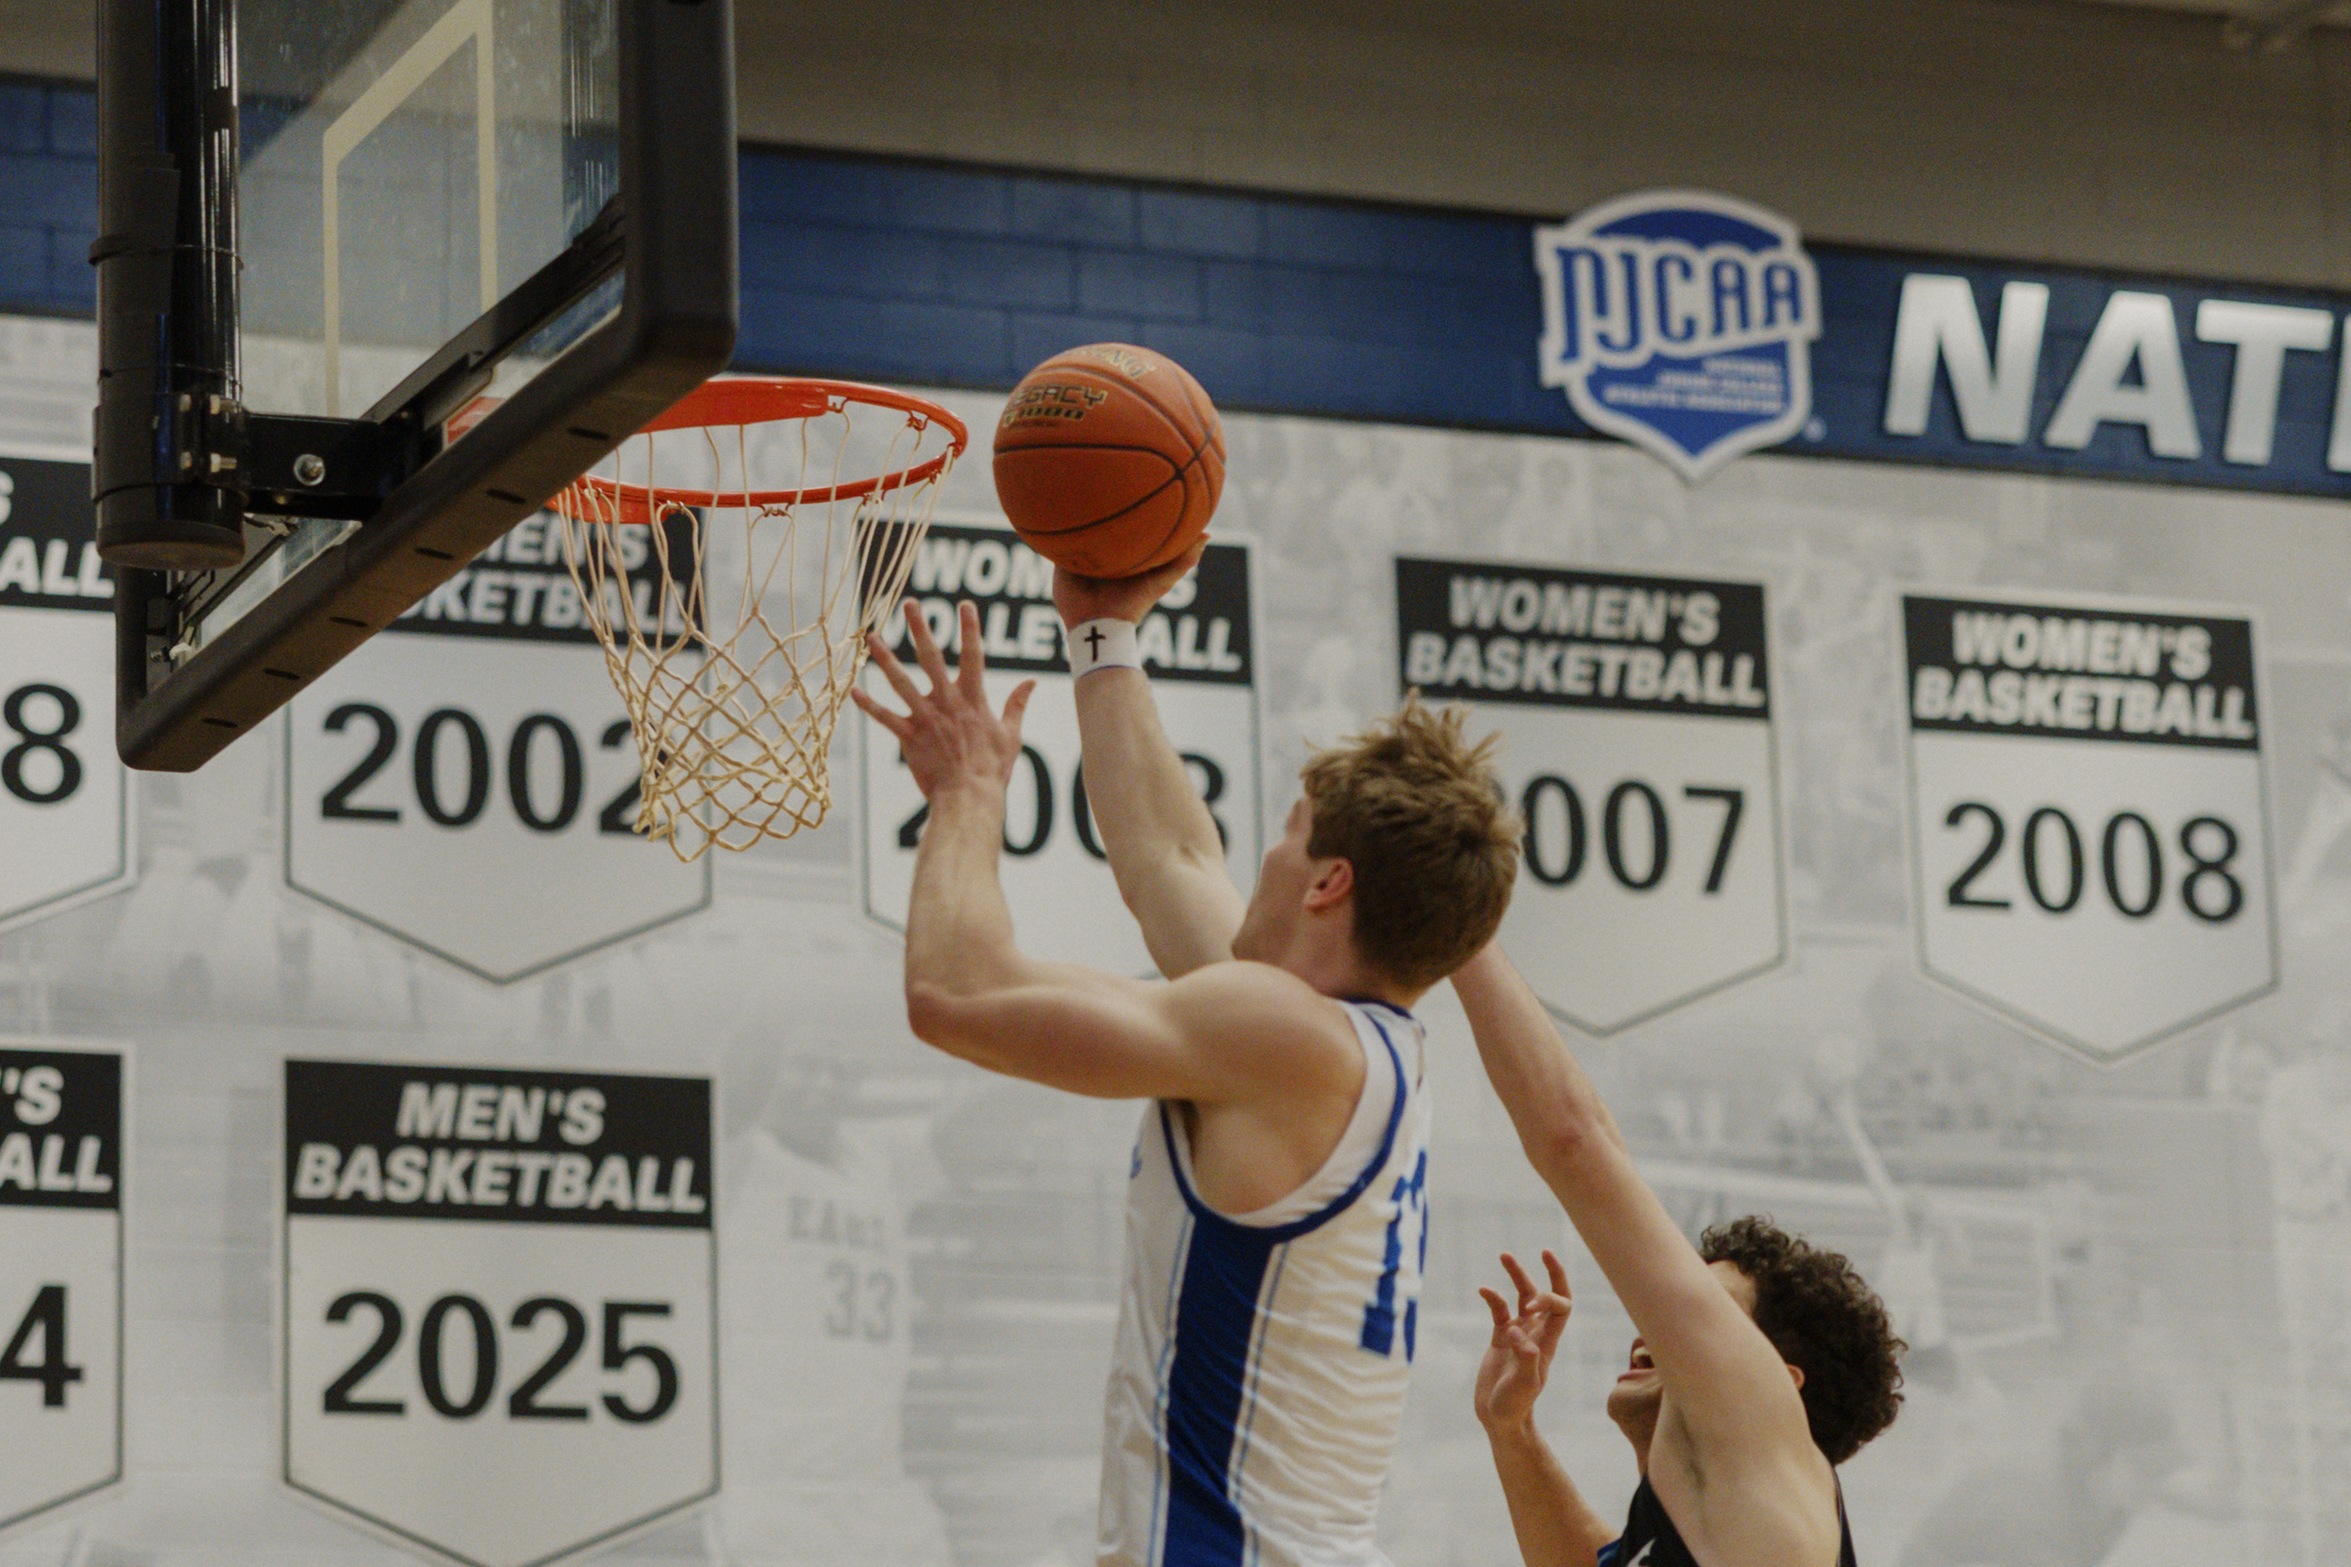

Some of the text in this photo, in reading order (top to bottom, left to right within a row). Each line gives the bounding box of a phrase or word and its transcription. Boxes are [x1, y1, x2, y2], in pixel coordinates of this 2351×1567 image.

[1555, 246, 1804, 362] NJCAA
[1885, 272, 2351, 473] NAT
[400, 568, 686, 636] KETBALL
[1449, 576, 1721, 646] WOMEN'S
[1405, 632, 1765, 709] BASKETBALL
[1952, 611, 2212, 680] WOMEN'S
[1913, 666, 2256, 739] BASKETBALL
[321, 702, 678, 834] 2002
[1518, 775, 1744, 894] 007
[1945, 802, 2244, 923] 2008
[398, 1081, 607, 1146] MEN'S
[293, 1142, 706, 1214] BASKETBALL
[323, 1292, 679, 1423] 2025
